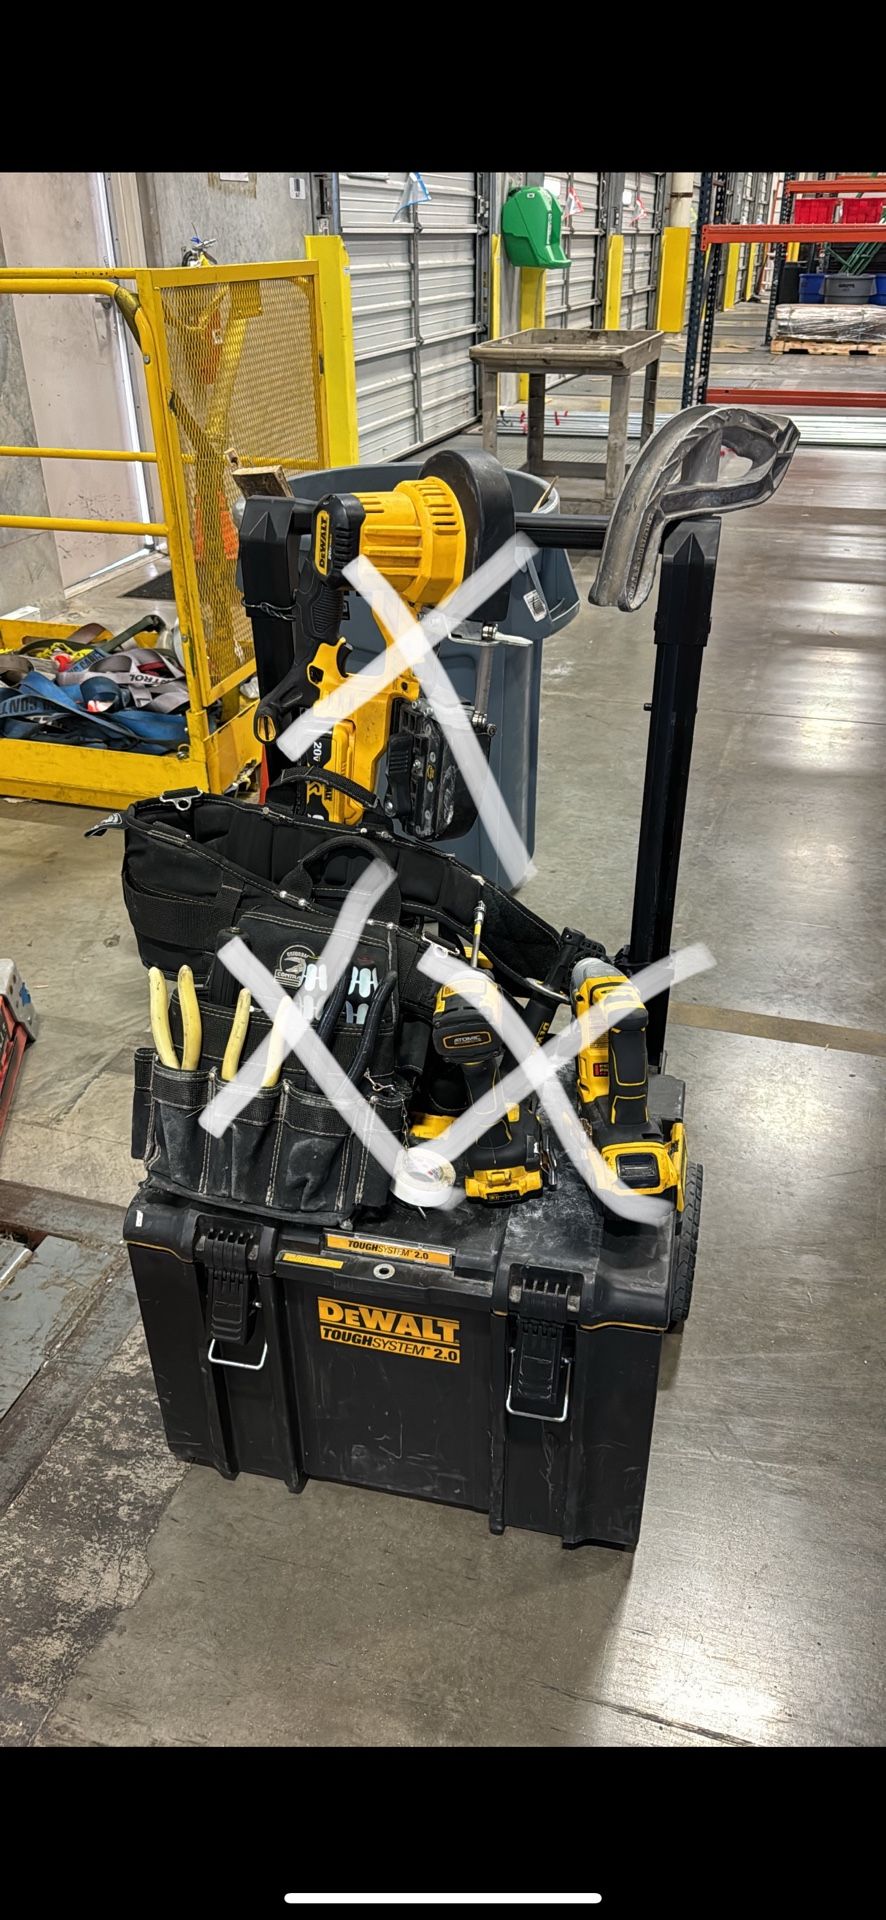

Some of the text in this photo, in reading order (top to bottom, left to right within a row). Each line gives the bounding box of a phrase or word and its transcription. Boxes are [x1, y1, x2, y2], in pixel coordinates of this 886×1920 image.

[319, 516, 327, 569] DEWALT
[454, 1035, 481, 1044] ATOMIC
[348, 1240, 429, 1260] TOUGHSYSTEM 2.0
[320, 1300, 460, 1343] DEWALT
[322, 1328, 458, 1361] TOUGHSYSTEM 2.0
